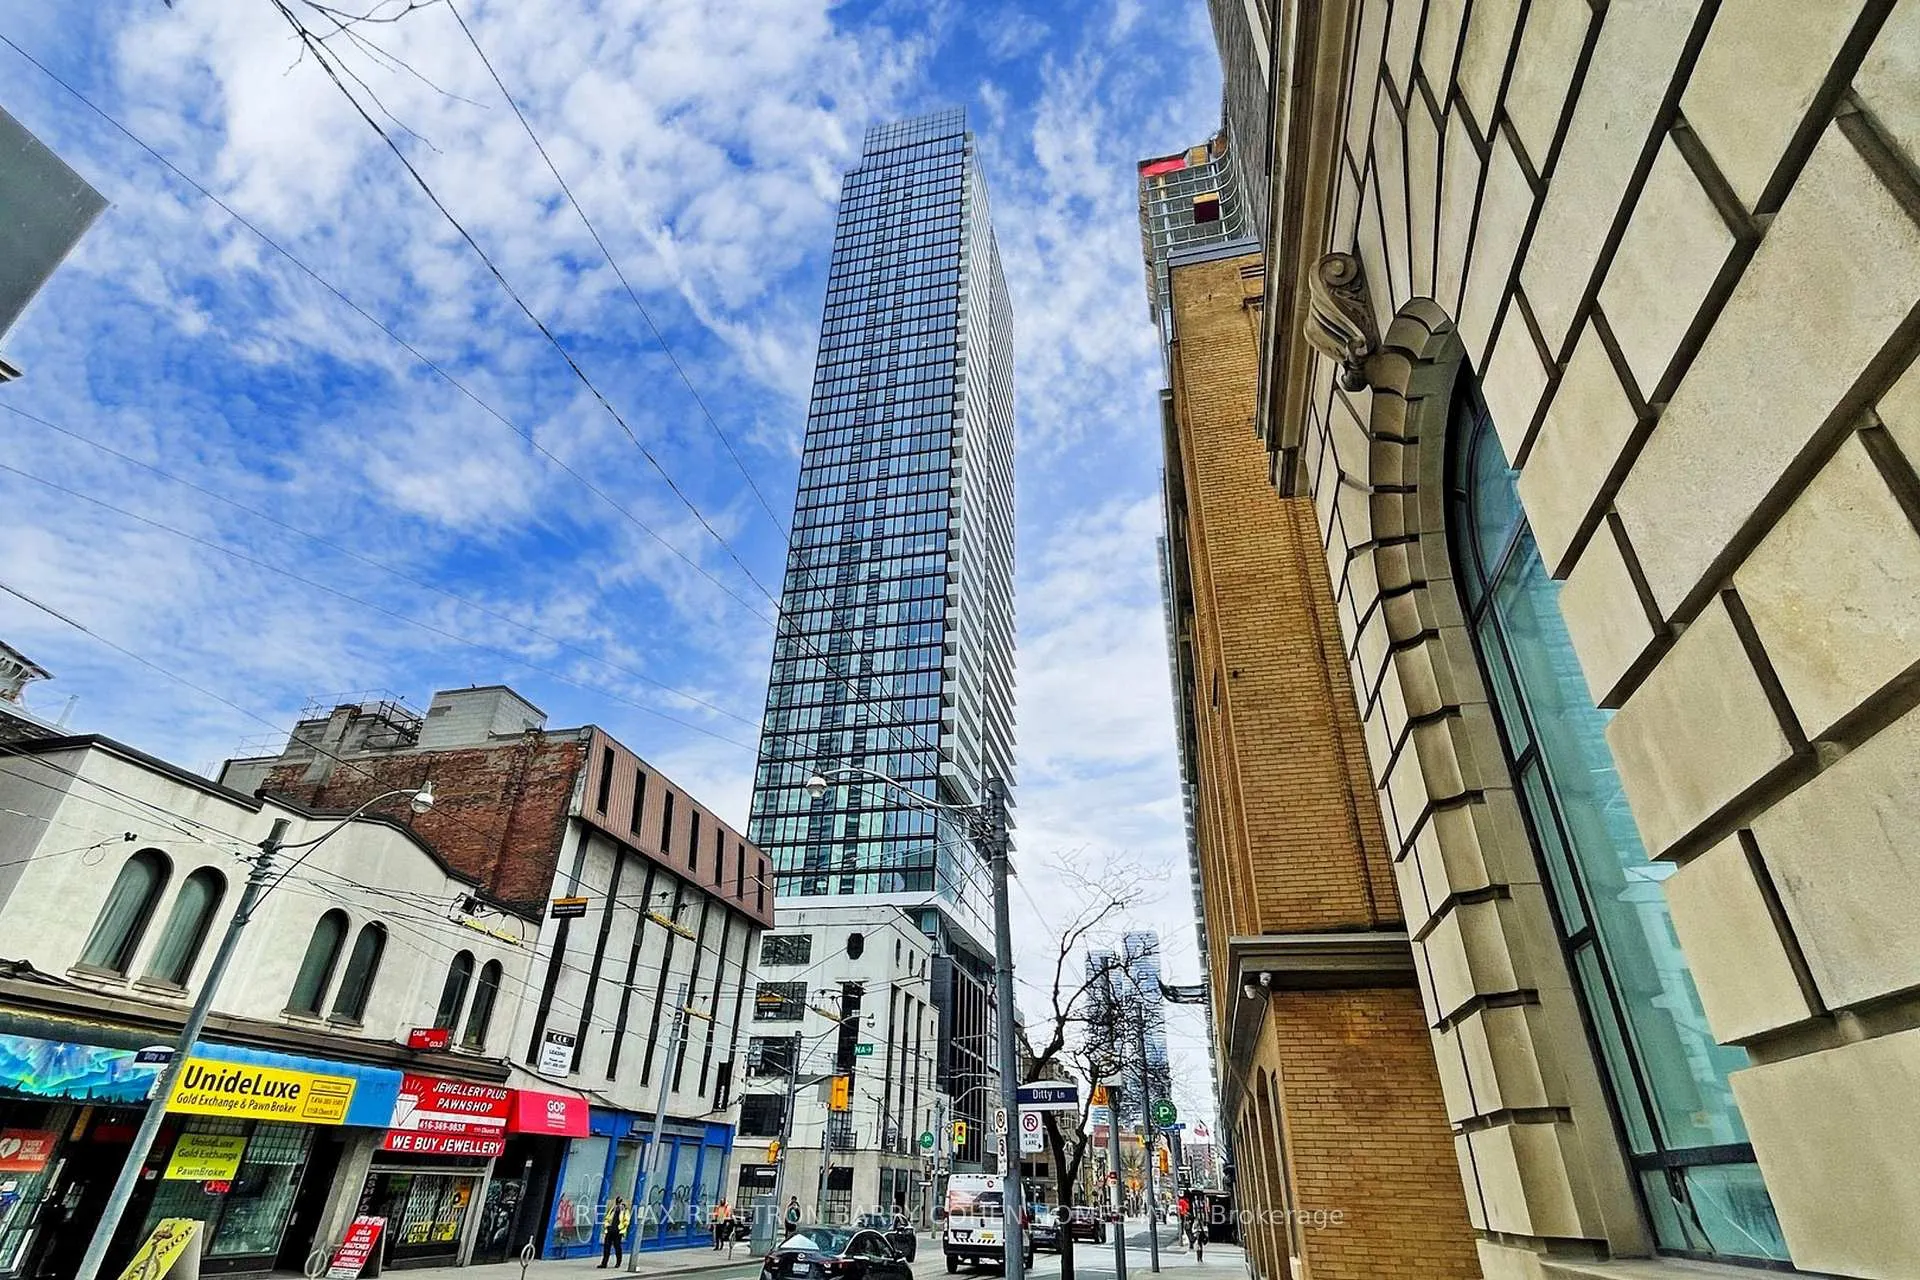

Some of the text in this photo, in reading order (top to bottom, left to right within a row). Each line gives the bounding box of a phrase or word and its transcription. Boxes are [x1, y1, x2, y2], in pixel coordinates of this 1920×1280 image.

[184, 1065, 300, 1099] UnideLuxe
[433, 1082, 507, 1100] JEWELLERY PLUS
[1032, 1089, 1052, 1101] Ditty
[177, 1092, 196, 1105] Gold
[199, 1094, 239, 1110] Exchange
[437, 1098, 493, 1113] PAWNSHOP
[547, 1100, 566, 1113] GOP
[392, 1135, 502, 1154] WE BUY JEWELLERY
[178, 1148, 199, 1158] Gold
